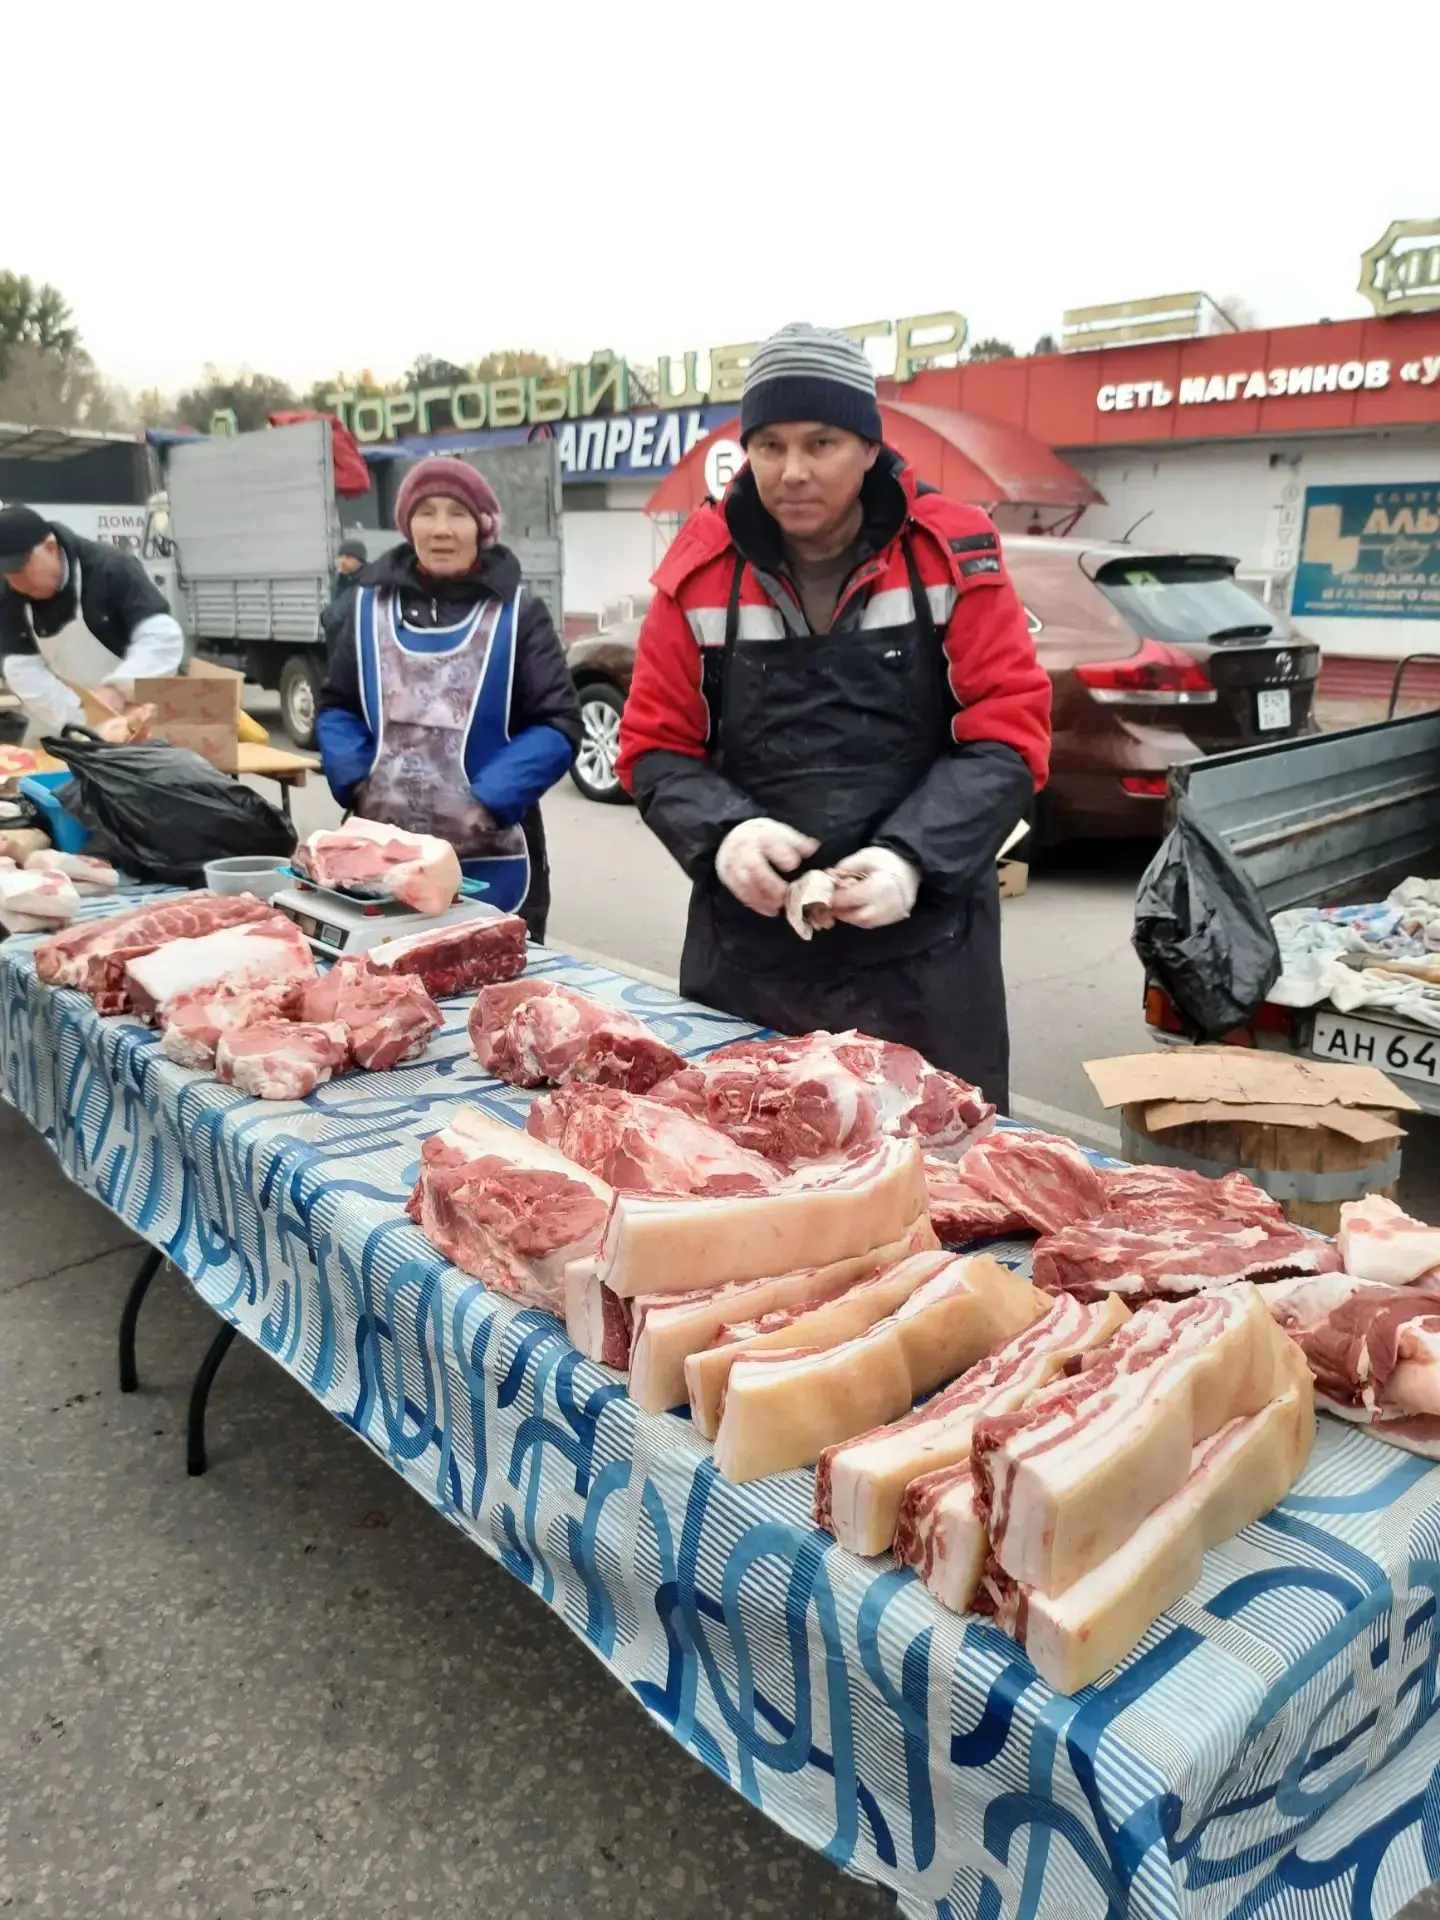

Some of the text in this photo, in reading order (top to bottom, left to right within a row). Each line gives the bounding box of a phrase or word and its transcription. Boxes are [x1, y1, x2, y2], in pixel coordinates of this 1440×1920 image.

[325, 311, 968, 442] ТОРГОВЫЙ ЦЕТР
[1096, 381, 1173, 412] СЕТЬ
[1178, 359, 1391, 405] МАГАЗИНОВ
[1328, 1028, 1437, 1077] АН 64
